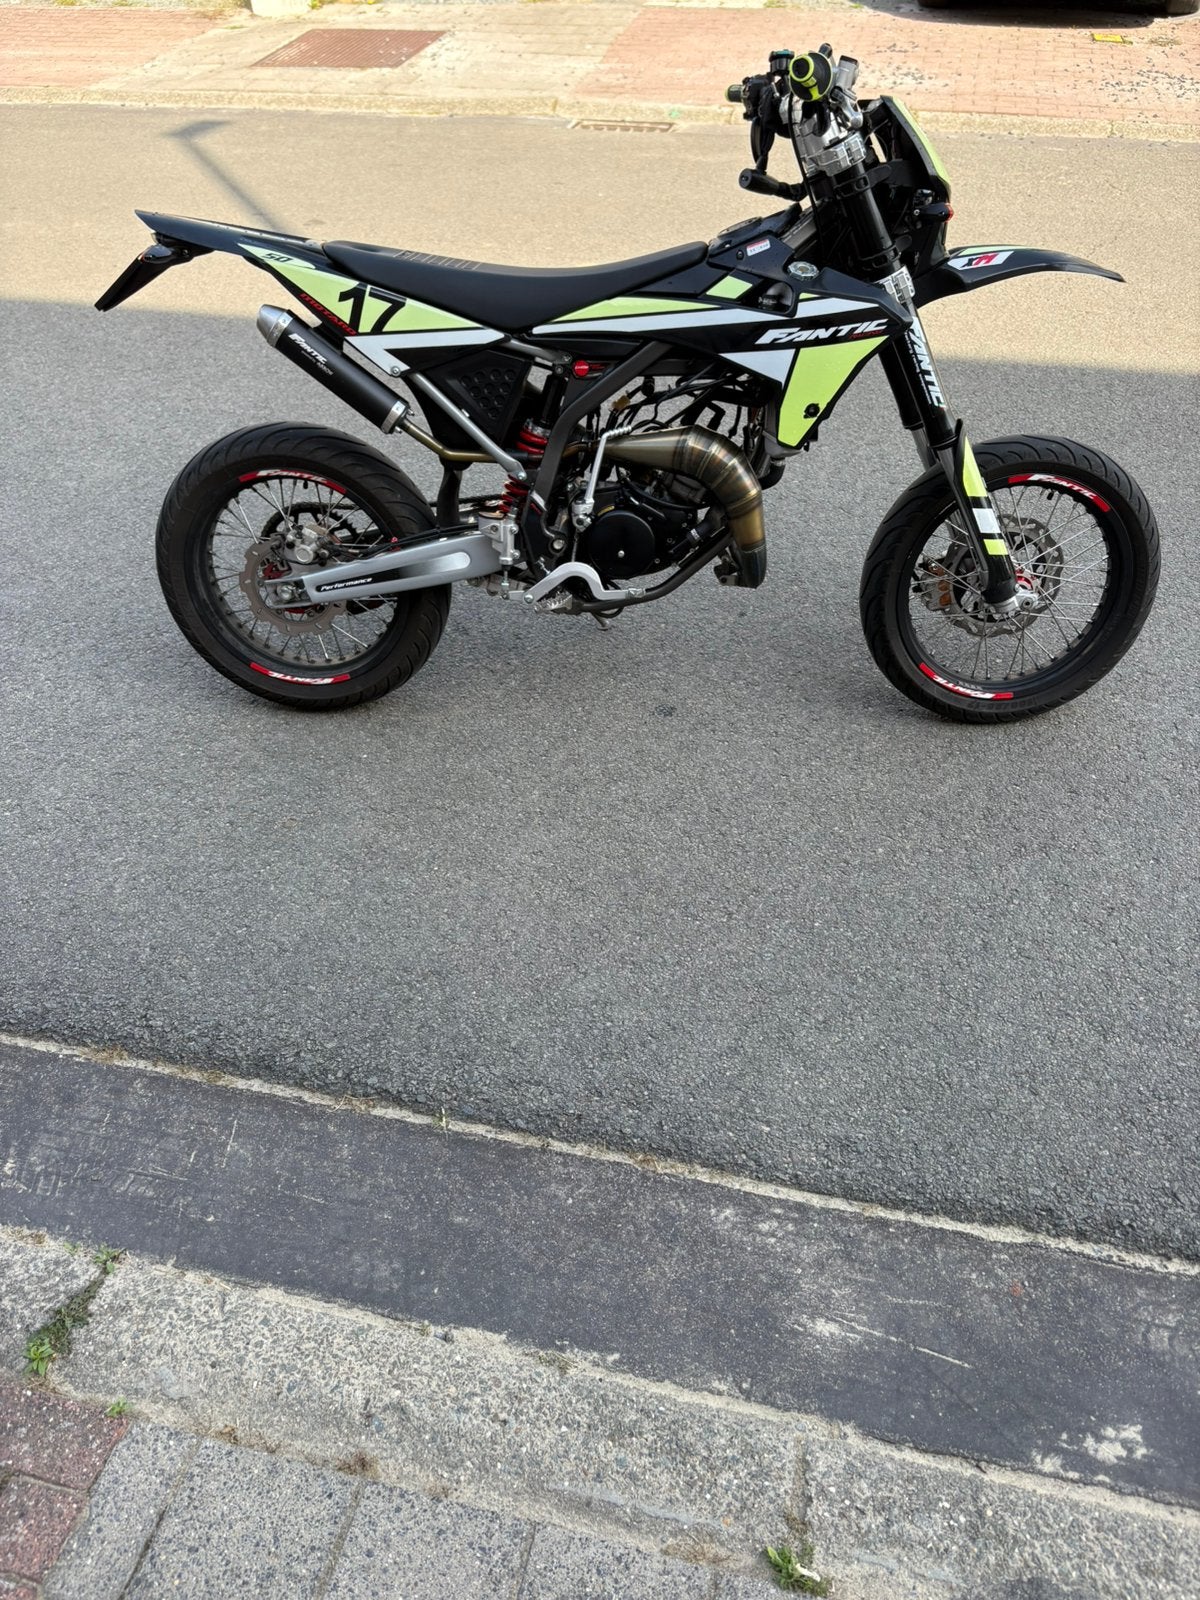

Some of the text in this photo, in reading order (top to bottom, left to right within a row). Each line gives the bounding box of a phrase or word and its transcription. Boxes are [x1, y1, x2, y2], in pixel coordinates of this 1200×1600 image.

[262, 252, 294, 263] 50
[338, 281, 407, 334] 17
[754, 318, 888, 344] FANTIC
[288, 333, 328, 365] FANTIC
[909, 316, 945, 407] FANTIC
[1027, 473, 1097, 499] FANTIC
[320, 577, 373, 592] Performance
